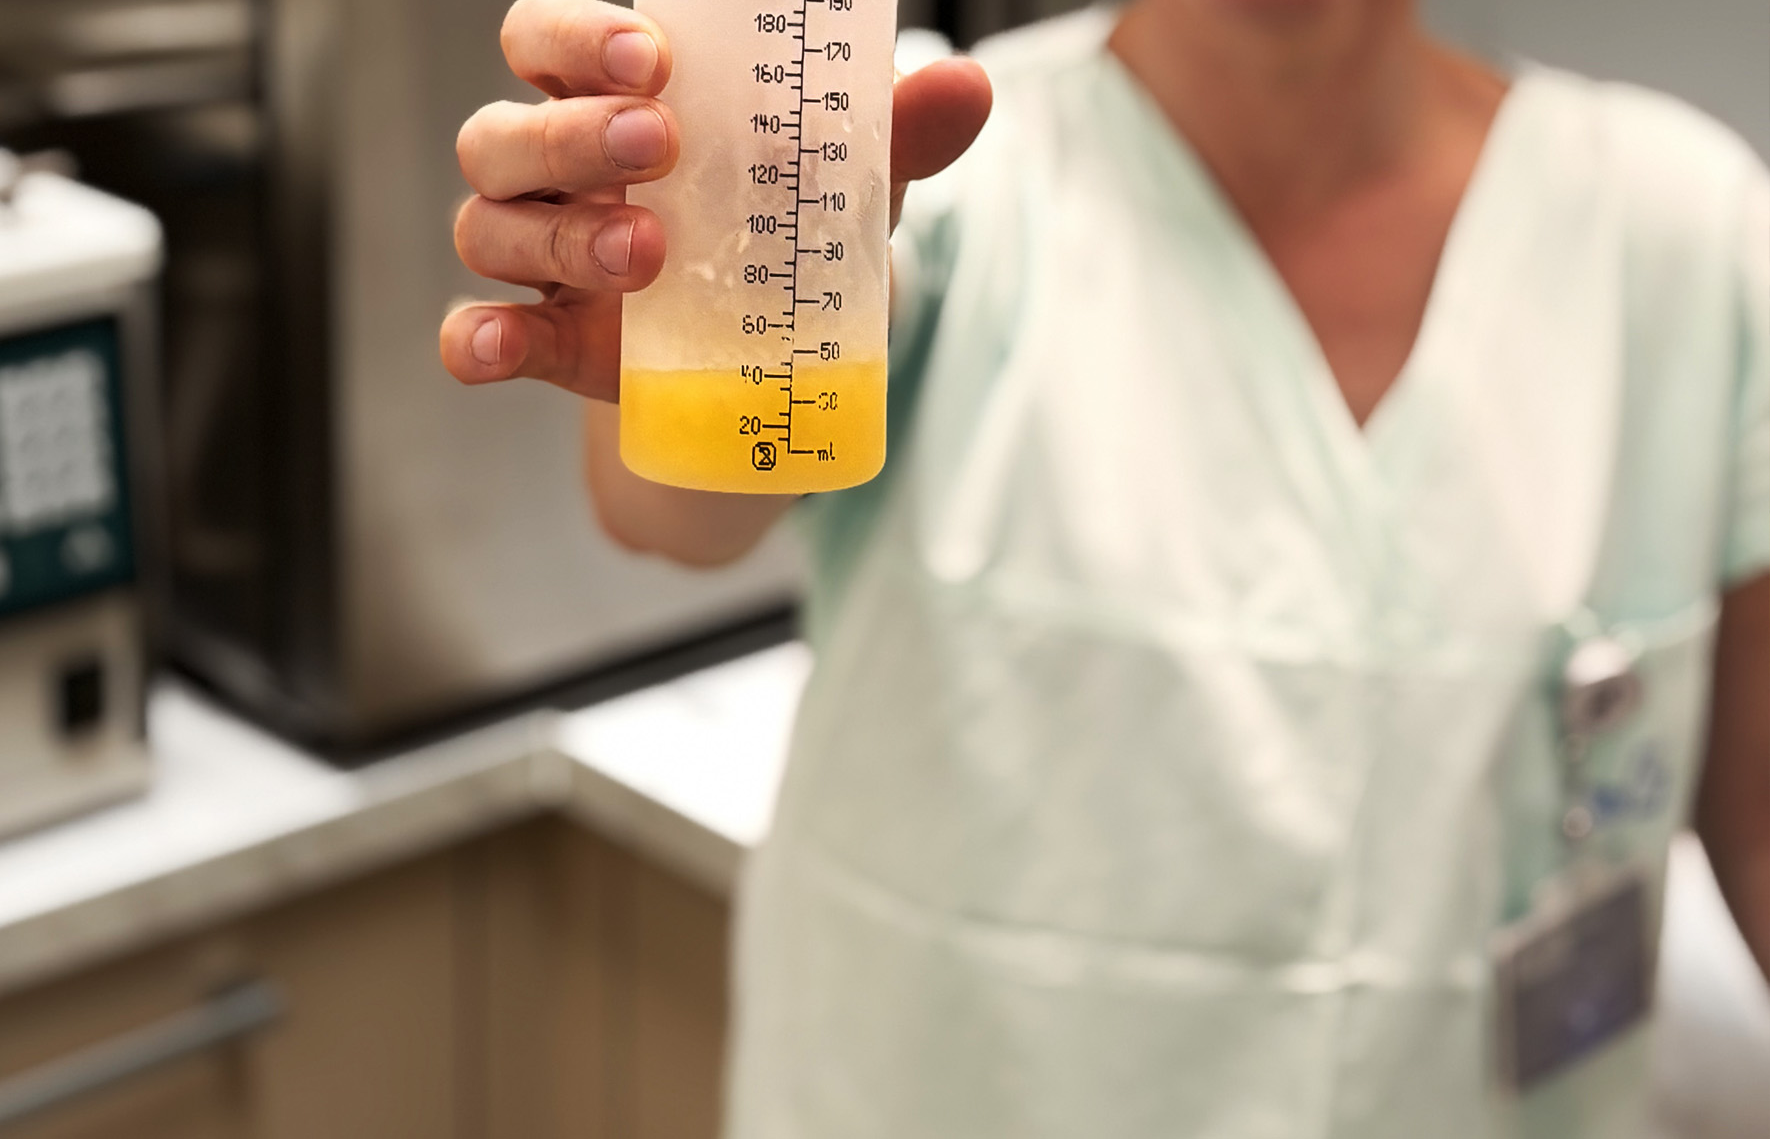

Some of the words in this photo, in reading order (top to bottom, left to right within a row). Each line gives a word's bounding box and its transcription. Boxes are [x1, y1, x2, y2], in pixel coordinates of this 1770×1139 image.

[754, 13, 786, 33] 180
[824, 42, 851, 61] 170
[752, 64, 784, 83] 160
[822, 92, 849, 111] 150
[750, 114, 780, 133] 140
[820, 142, 847, 161] 130
[748, 164, 778, 184] 120
[820, 192, 845, 212] 110
[747, 215, 777, 234] 100
[744, 265, 768, 284] 80
[822, 292, 842, 311] 70
[742, 315, 767, 334] 60
[820, 342, 840, 361] 50
[741, 365, 762, 385] 40
[739, 416, 761, 435] 20
[817, 442, 835, 461] ml
